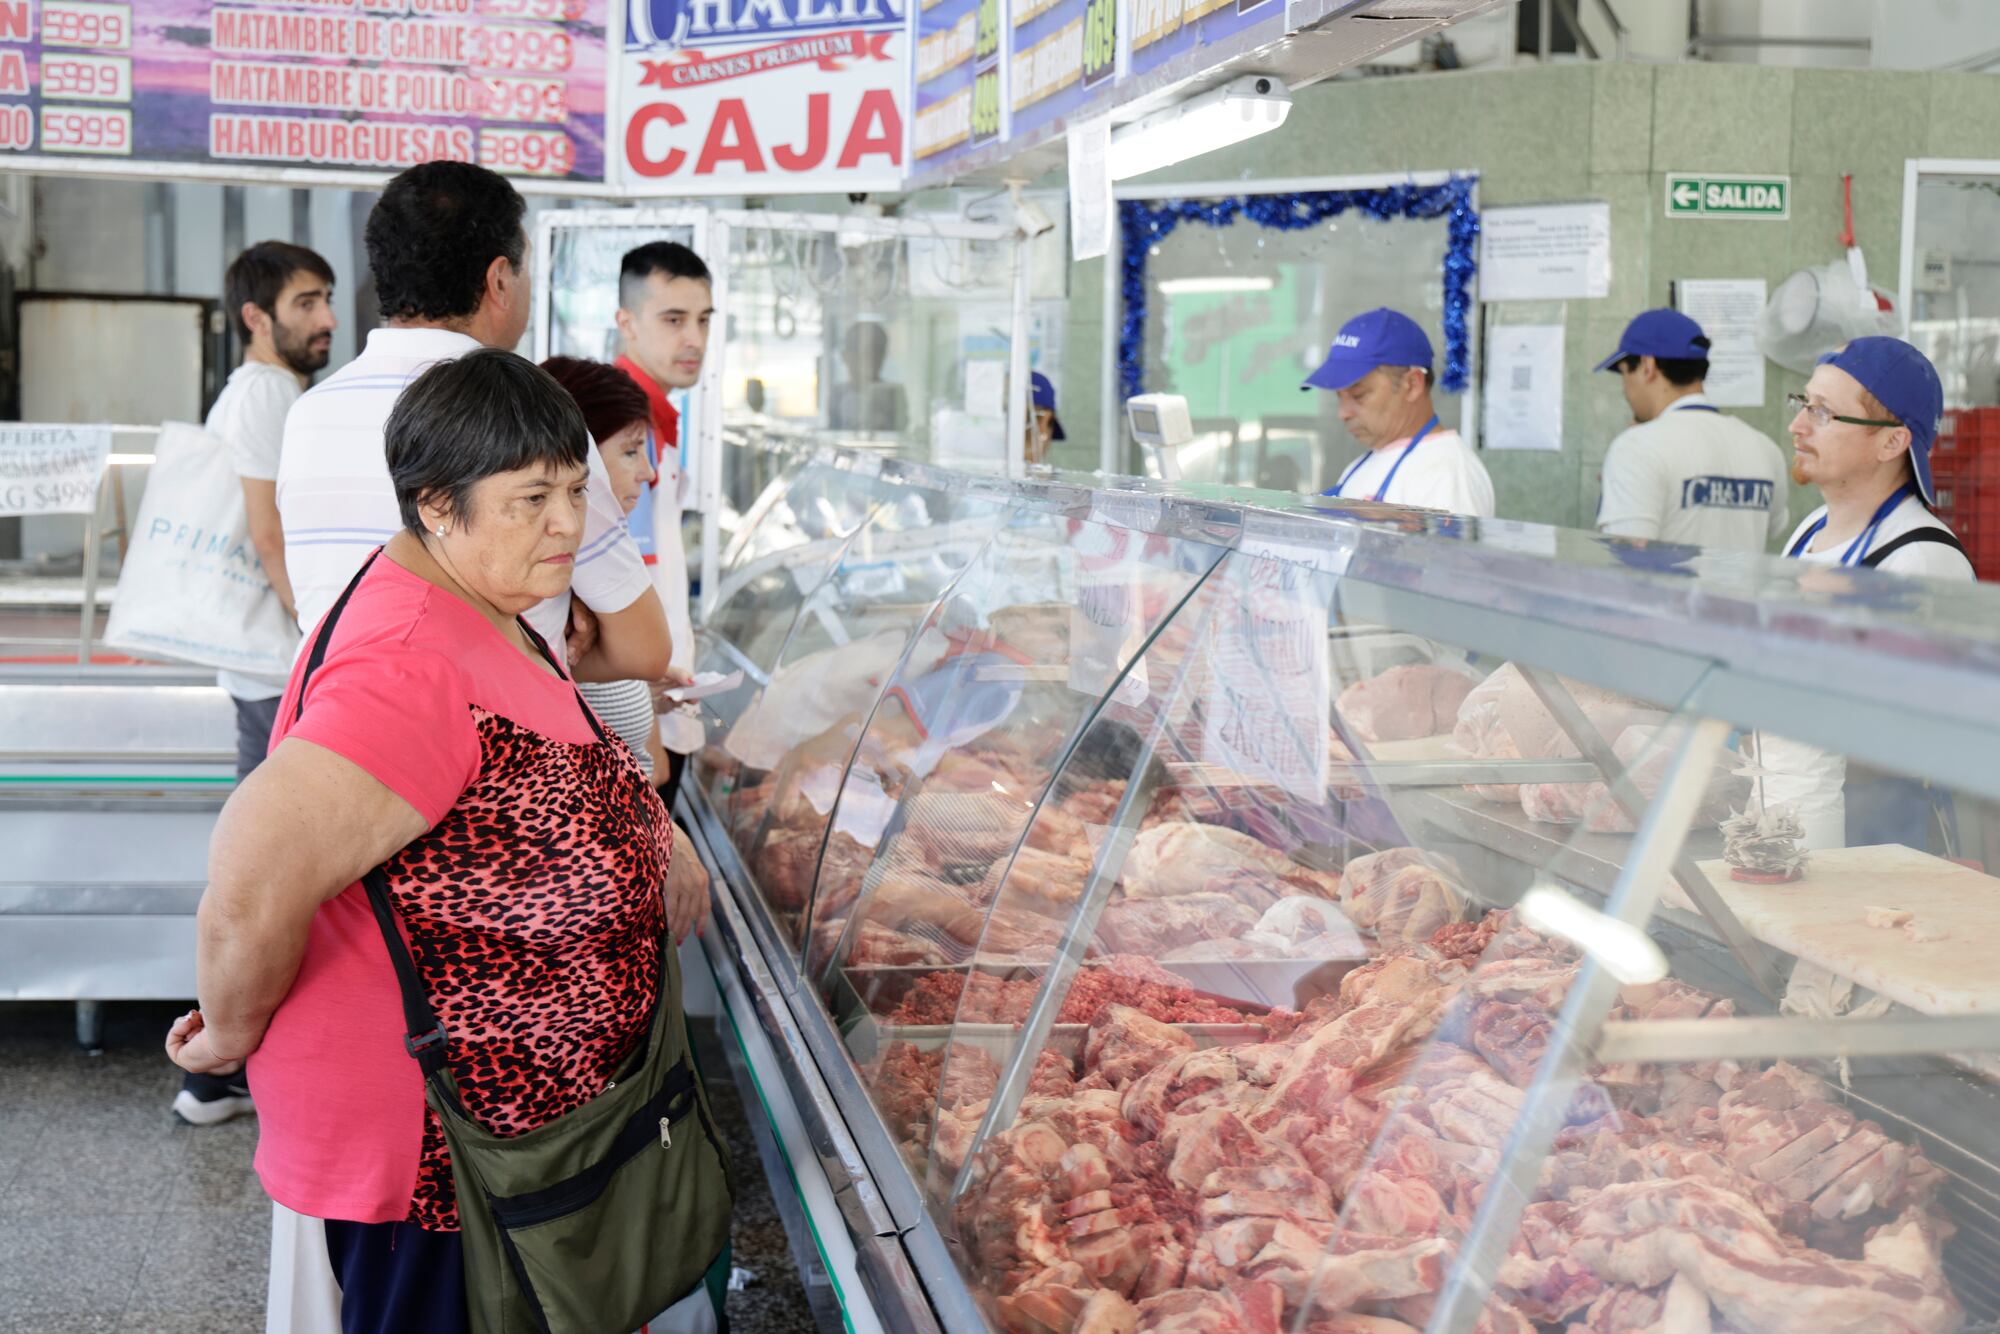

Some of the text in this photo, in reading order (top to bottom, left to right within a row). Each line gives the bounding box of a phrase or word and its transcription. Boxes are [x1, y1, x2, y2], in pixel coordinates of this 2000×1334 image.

[216, 12, 346, 54] MATAMBRE
[355, 20, 383, 56] DE
[390, 22, 464, 61] CARNE
[672, 34, 852, 84] CARNES PREMIUM
[216, 64, 351, 107] MATAMBRE
[359, 71, 388, 108] DE
[396, 74, 467, 113] POLLO
[45, 114, 124, 146] 5999
[214, 118, 577, 176] HAMBURGUESAS 3899
[625, 89, 903, 178] CAJA
[1706, 184, 1782, 209] SALIDA
[0, 485, 26, 509] G
[1685, 477, 1772, 510] CHALIN
